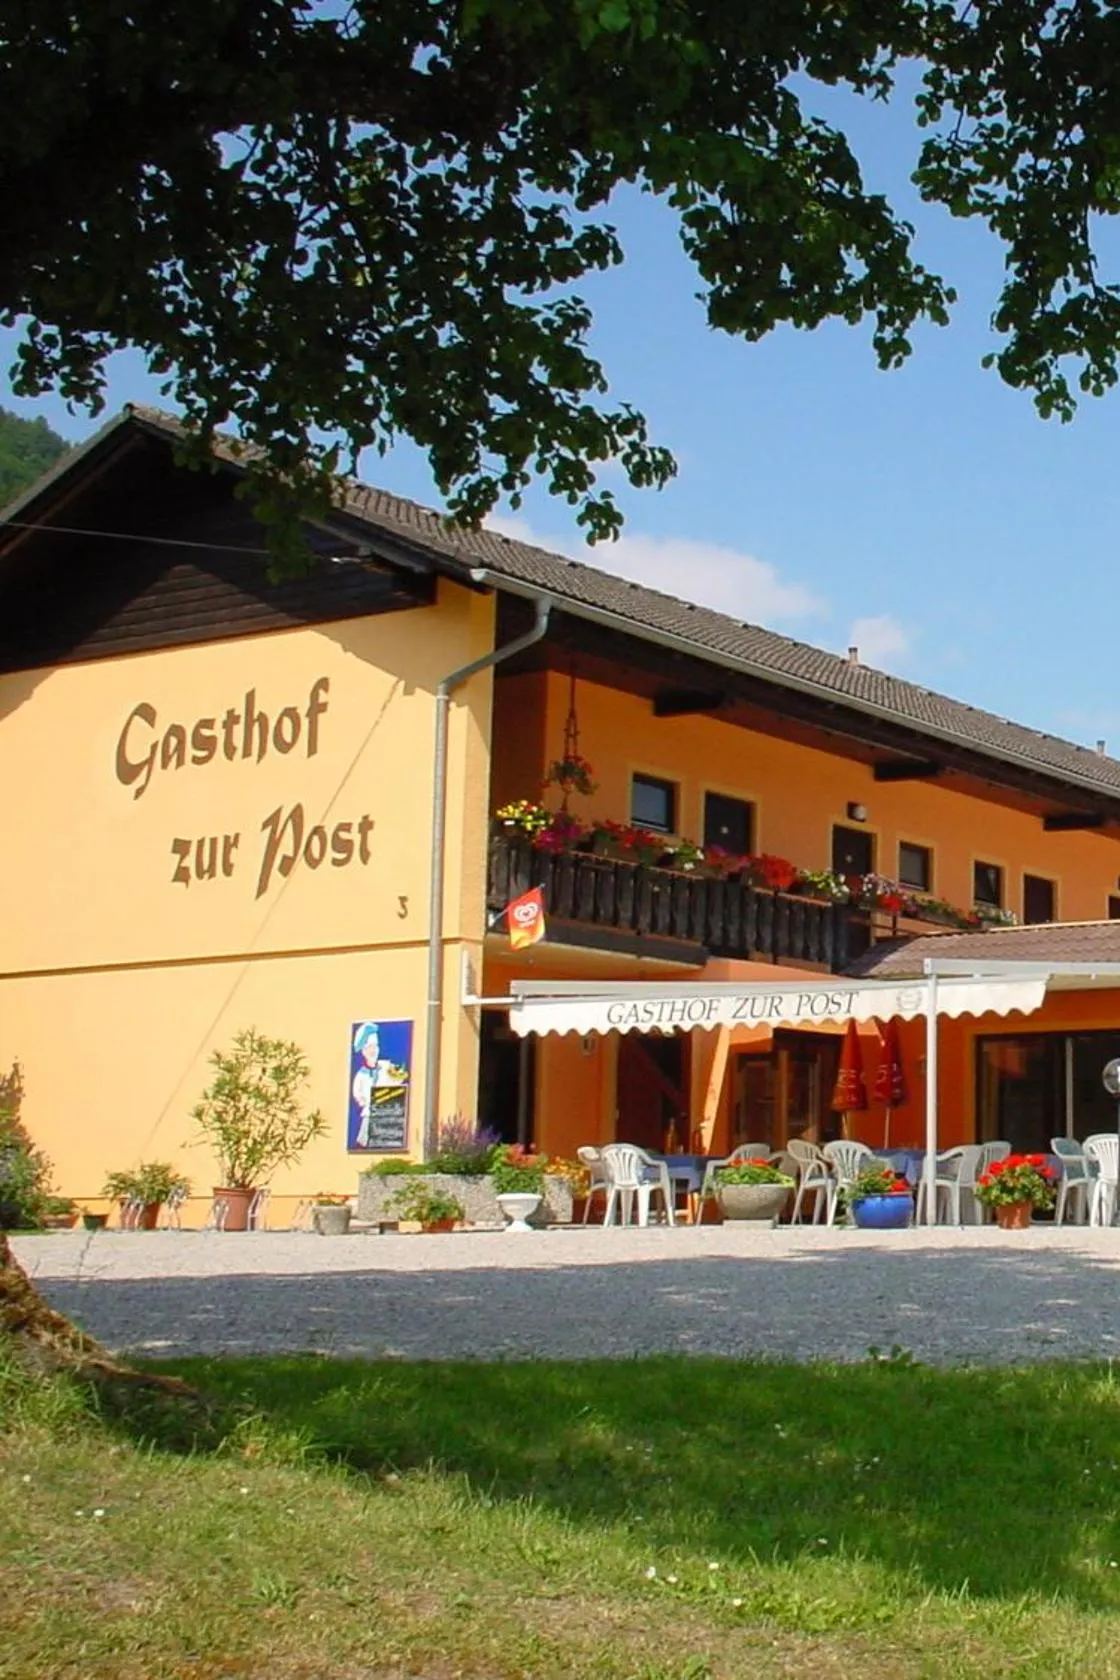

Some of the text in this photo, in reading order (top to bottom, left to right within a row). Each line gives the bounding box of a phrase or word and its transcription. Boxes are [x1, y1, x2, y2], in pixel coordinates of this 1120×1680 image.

[115, 676, 330, 801] Gasthof
[171, 802, 375, 901] zur Post
[607, 991, 859, 1024] GASTHOF ZUR POST
